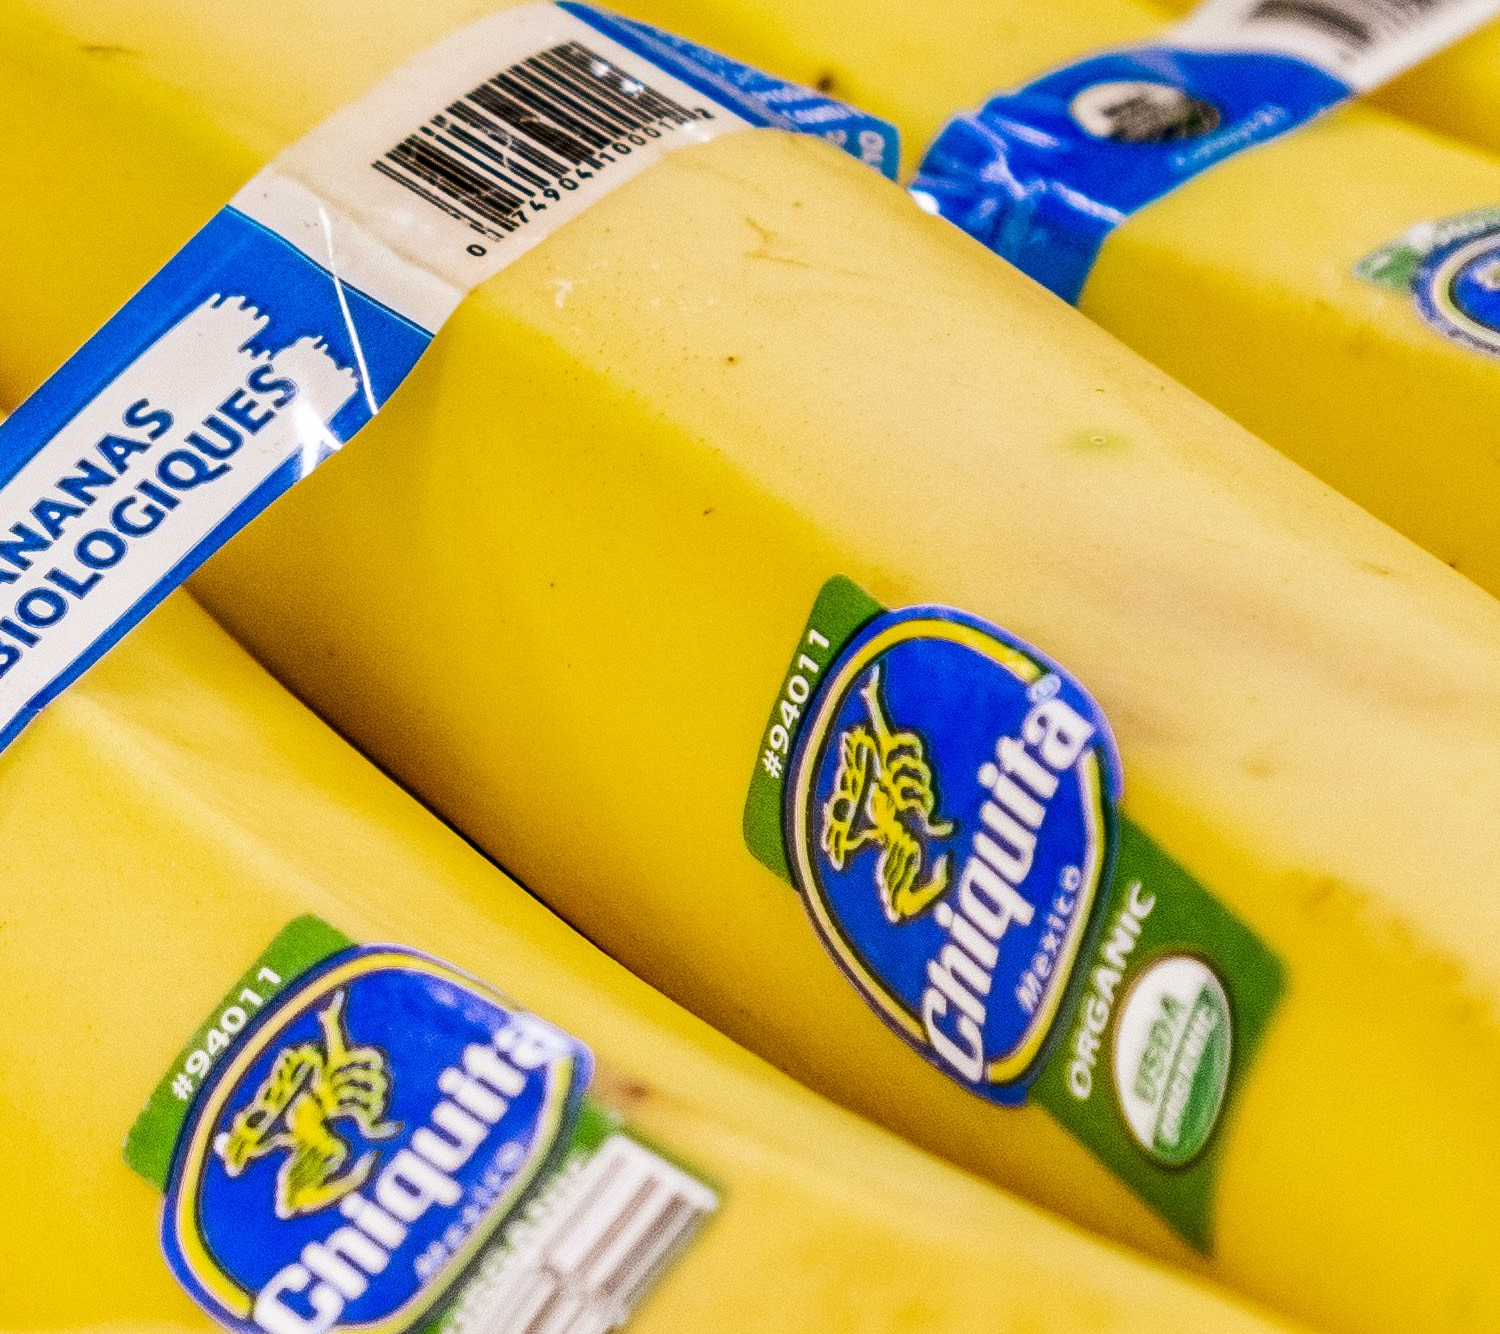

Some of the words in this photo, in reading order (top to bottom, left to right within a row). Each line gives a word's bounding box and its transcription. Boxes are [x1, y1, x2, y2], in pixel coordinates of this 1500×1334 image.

[762, 628, 831, 779] #94011
[923, 698, 1095, 1083] Chiquita
[170, 966, 282, 1100] #94011
[1068, 881, 1156, 1101] ORGANIC
